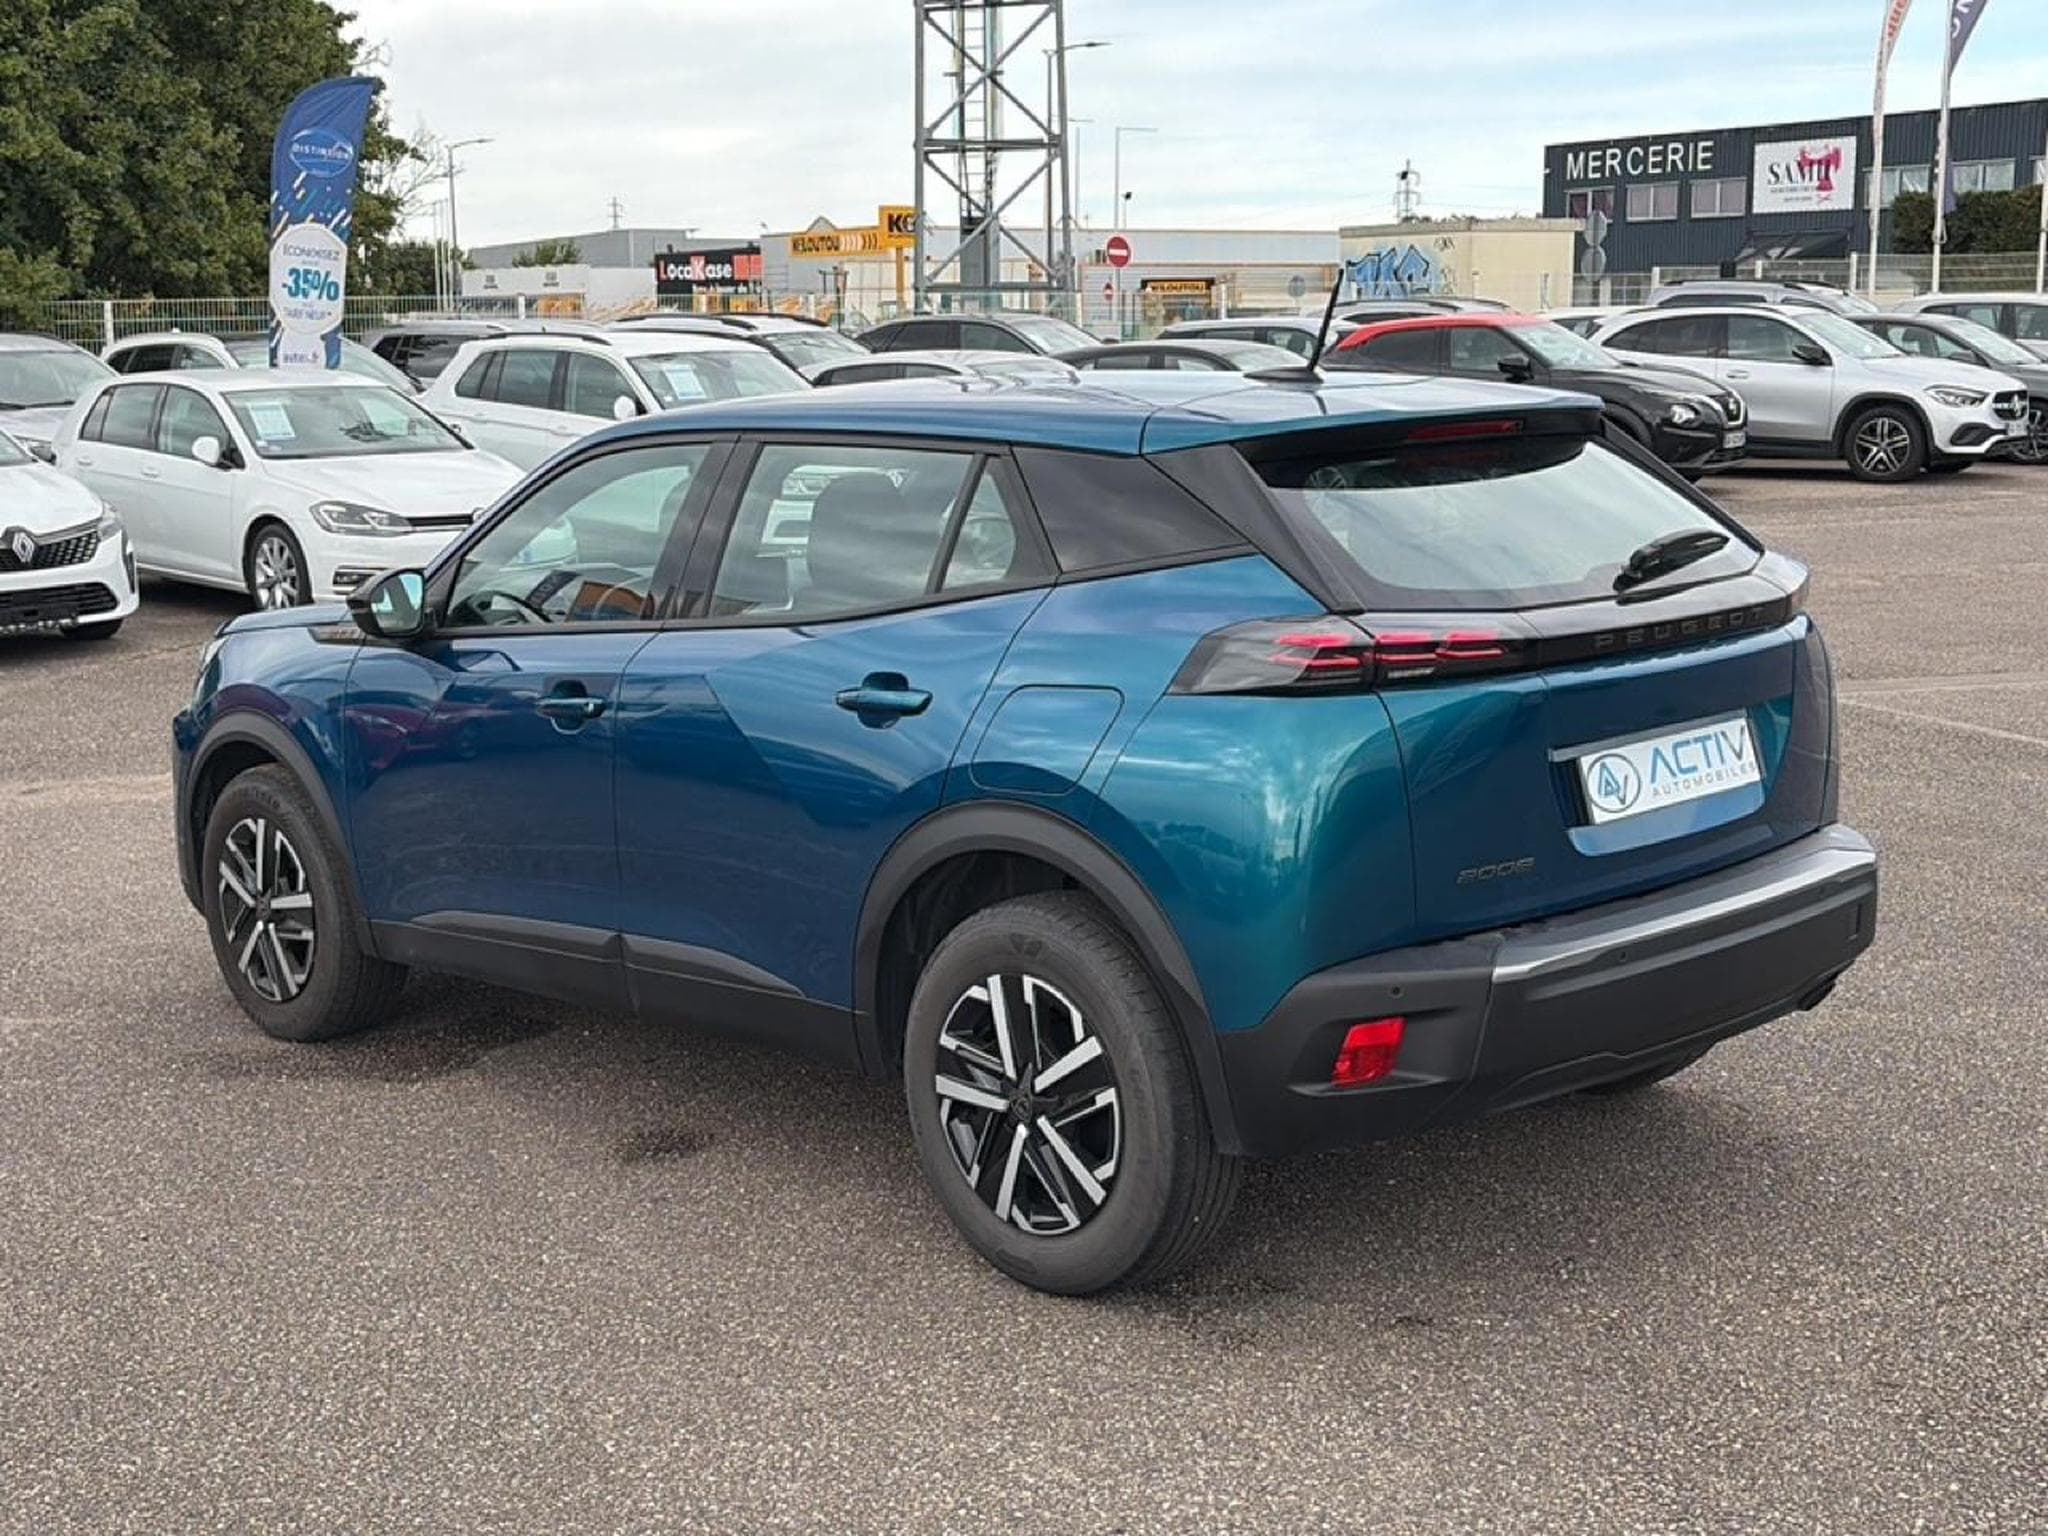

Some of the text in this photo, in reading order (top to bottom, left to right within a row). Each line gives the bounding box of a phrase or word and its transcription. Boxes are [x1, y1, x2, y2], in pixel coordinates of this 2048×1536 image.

[1565, 140, 1715, 180] MERCERIE
[281, 267, 341, 302] -35%
[659, 255, 733, 281] LocaKase
[1593, 607, 1764, 650] PEUGEOT
[1650, 724, 1746, 785] ACTIV
[1652, 761, 1756, 797] AUTOMOBILES
[1455, 856, 1536, 885] 2008
